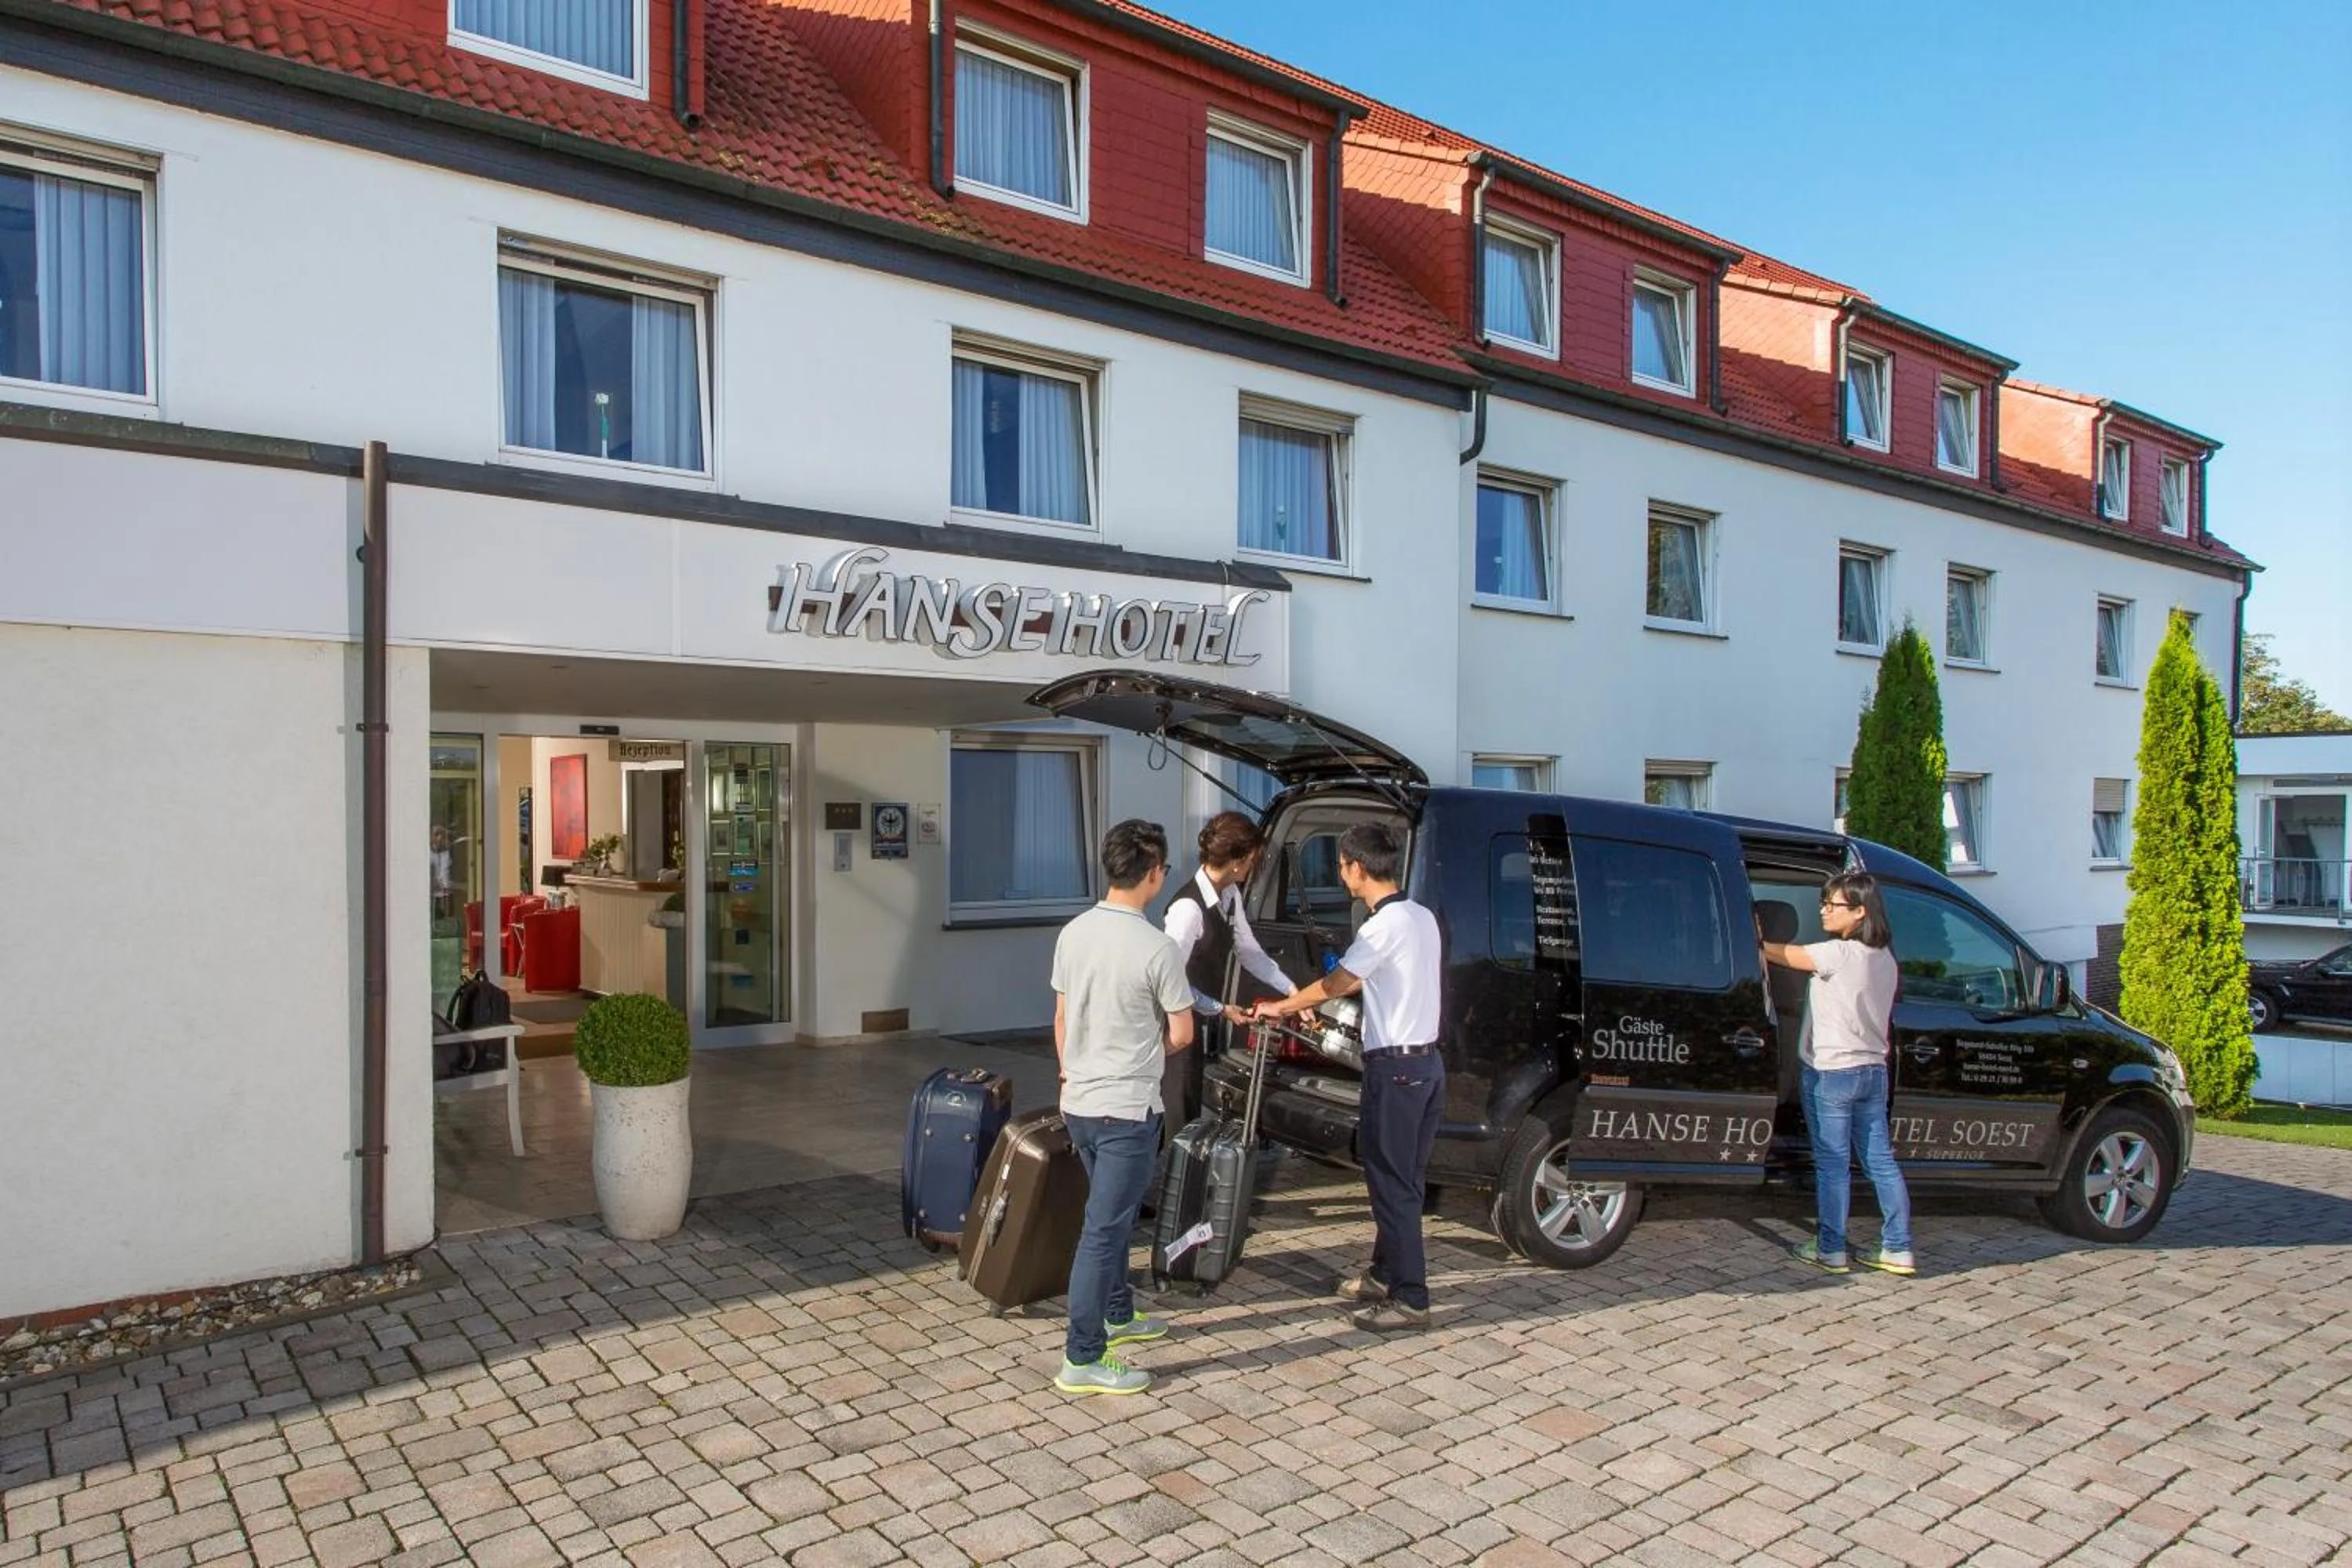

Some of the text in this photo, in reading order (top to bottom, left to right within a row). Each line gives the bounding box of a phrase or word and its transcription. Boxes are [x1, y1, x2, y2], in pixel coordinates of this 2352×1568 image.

[620, 742, 672, 758] Rezeption
[1619, 1015, 1664, 1035] Gäste
[1592, 1029, 1690, 1063] Shuttle
[1588, 1109, 1773, 1145] HANSE HO
[1950, 1120, 2035, 1147] SOEST
[1926, 1149, 1987, 1160] SUPERIOR
